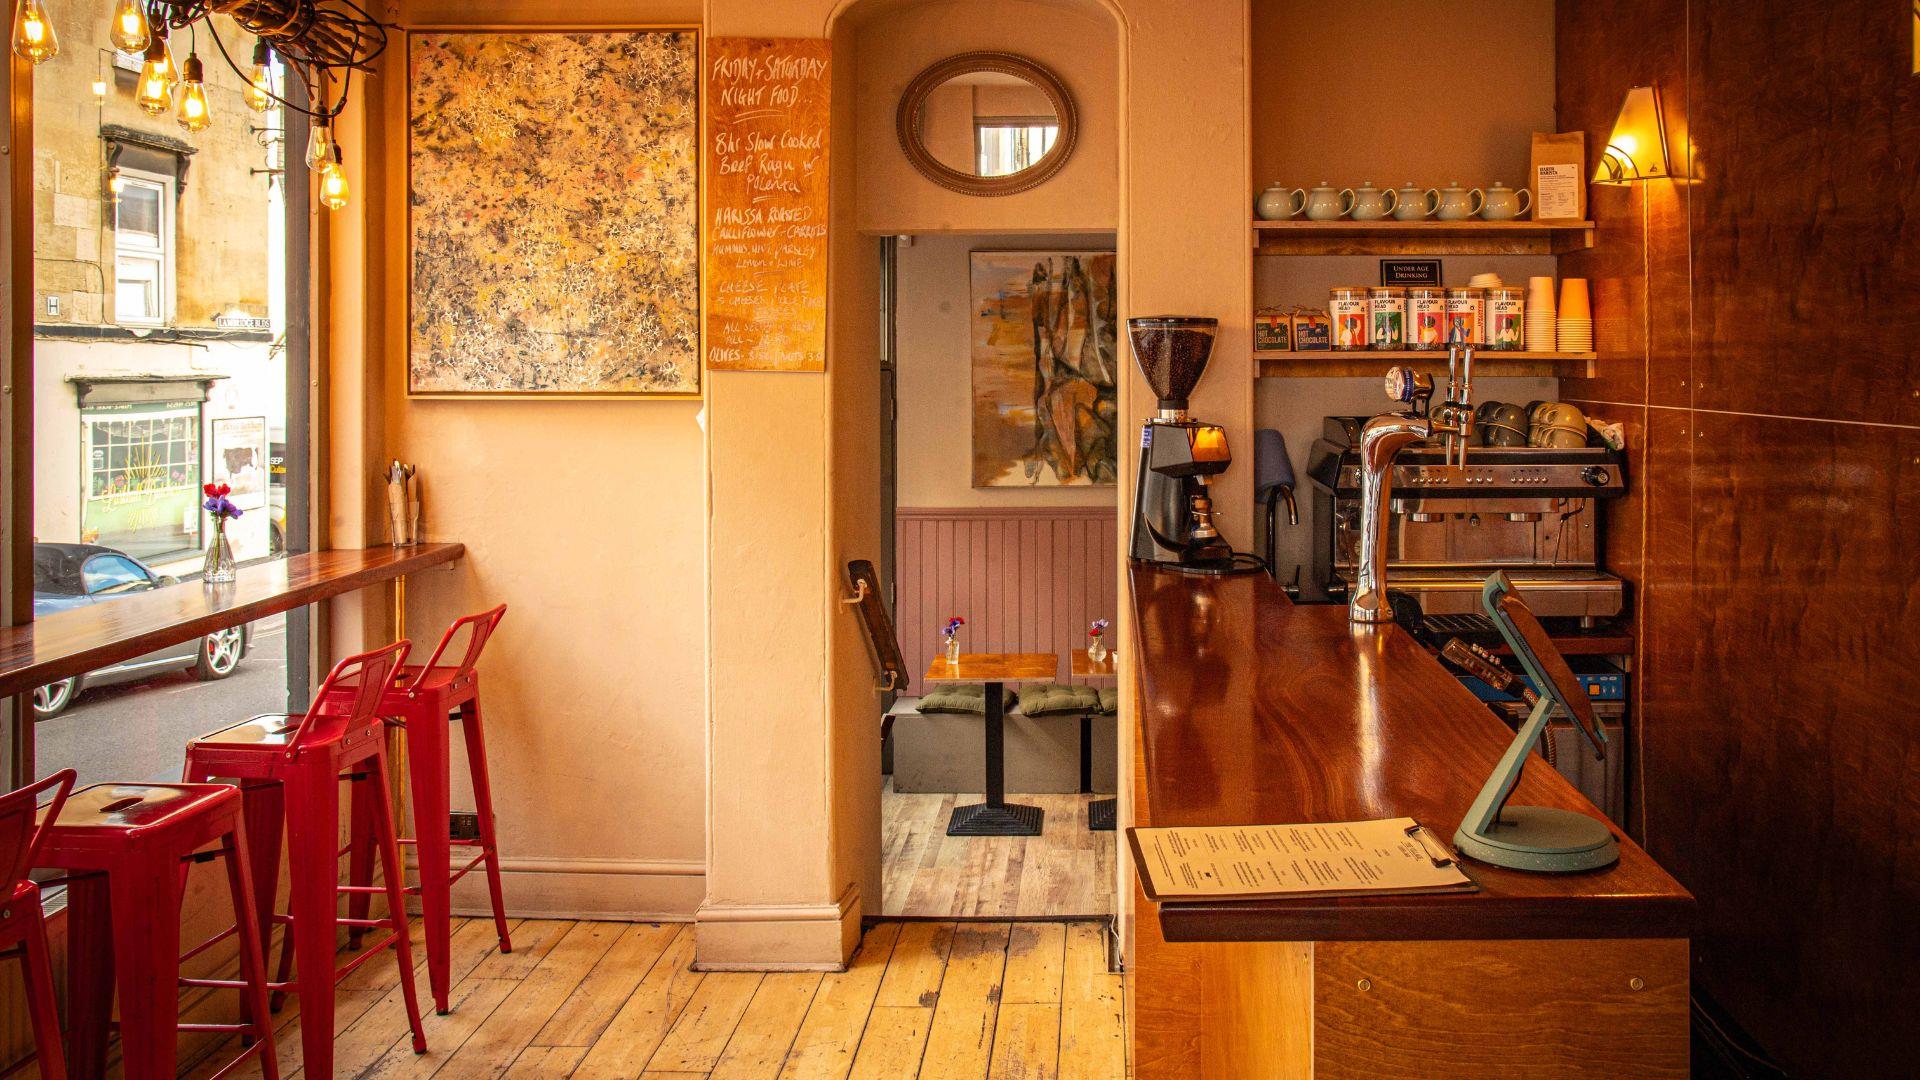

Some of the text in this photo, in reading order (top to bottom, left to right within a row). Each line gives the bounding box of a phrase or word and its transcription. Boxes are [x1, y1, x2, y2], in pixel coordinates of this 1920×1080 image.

[712, 56, 757, 85] FRIDAY
[764, 55, 828, 85] SATURDAY
[721, 86, 767, 106] NIGHT
[745, 132, 776, 152] Slow
[781, 129, 822, 149] Cooked
[759, 153, 794, 178] Ragu
[716, 207, 762, 227] HARISSA
[49, 298, 58, 313] H
